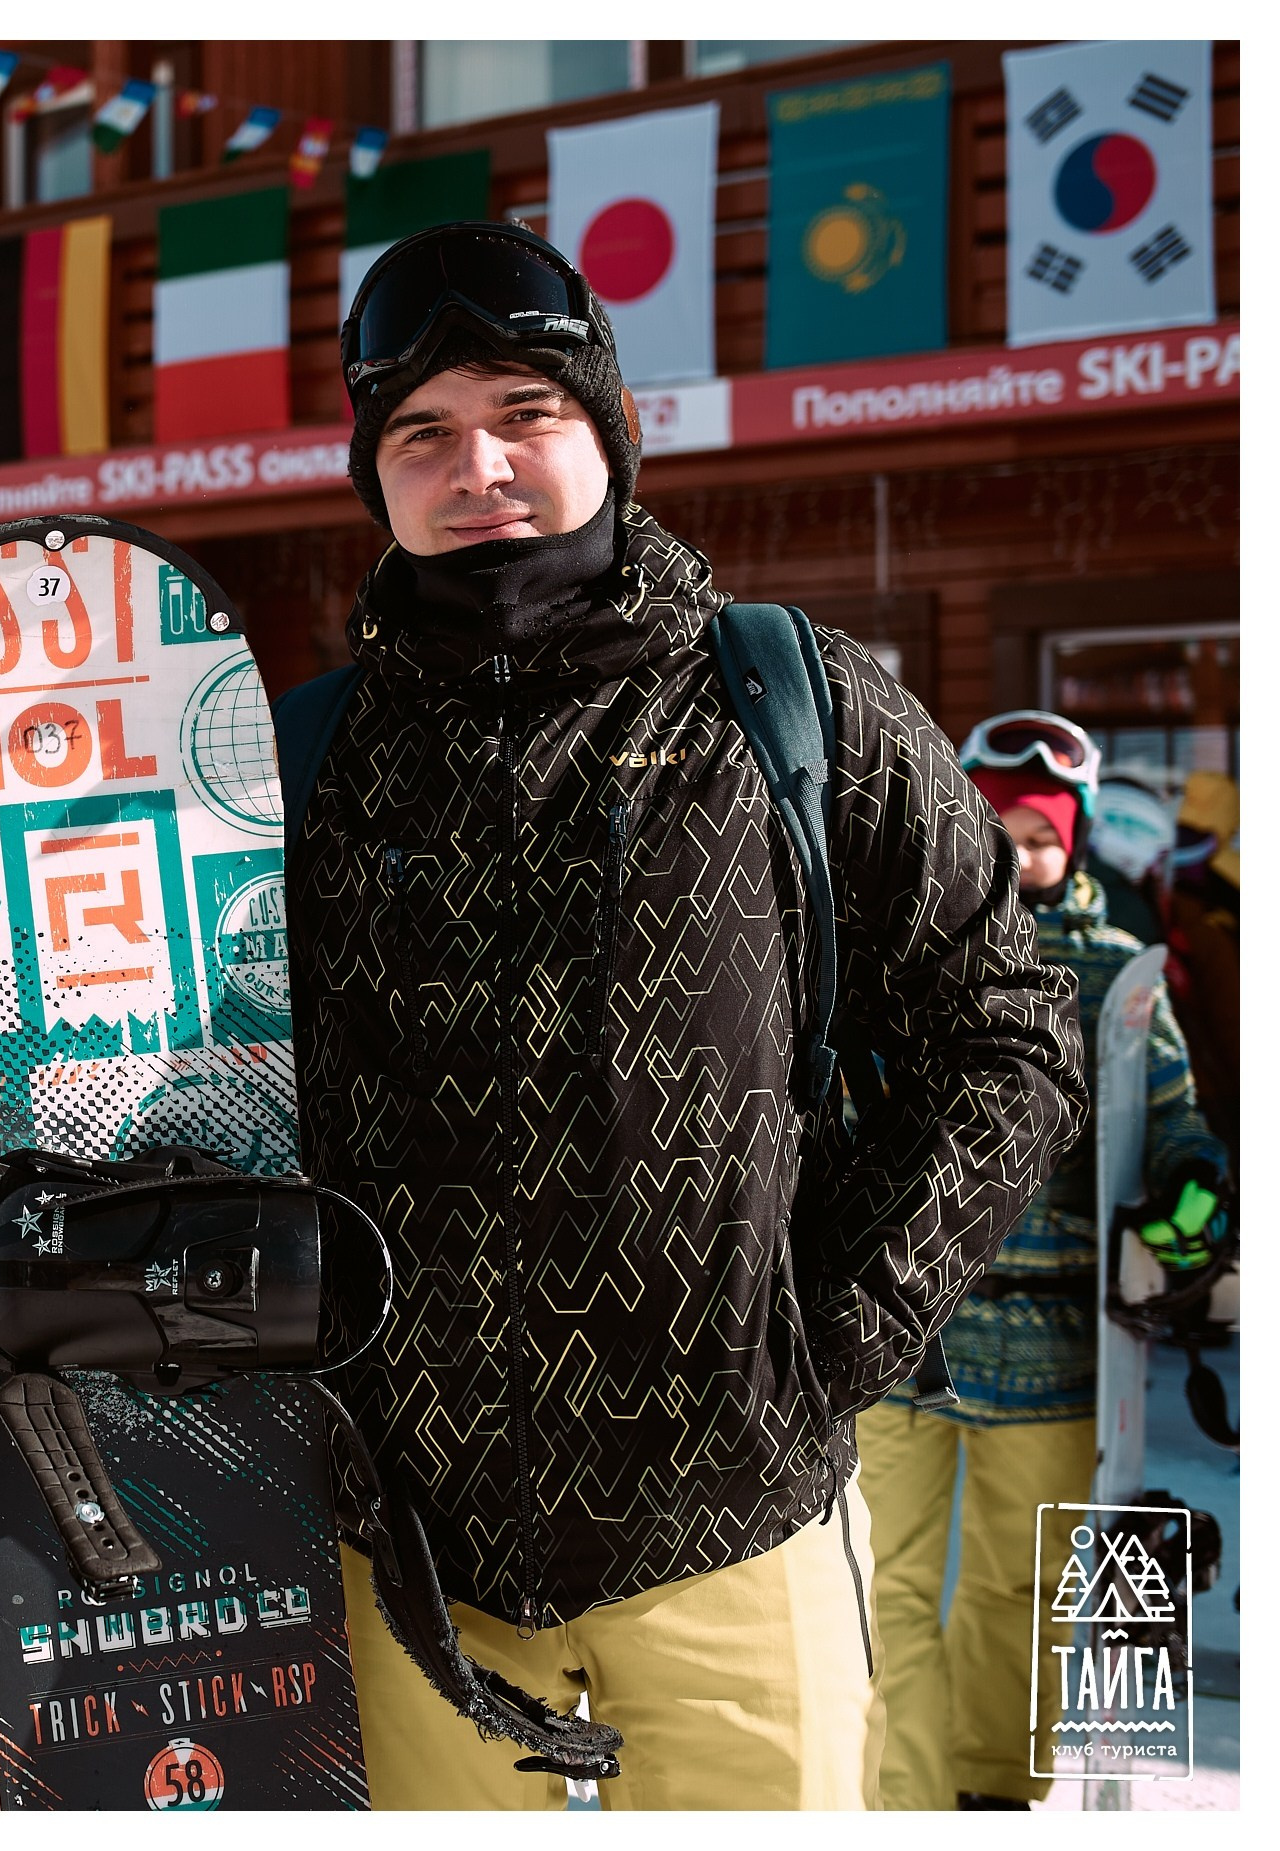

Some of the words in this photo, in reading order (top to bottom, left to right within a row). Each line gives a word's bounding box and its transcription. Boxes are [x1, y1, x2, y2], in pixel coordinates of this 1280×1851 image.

[793, 363, 1063, 429] Пополняйте
[98, 443, 254, 501] SKI-PASS
[38, 577, 61, 597] 37
[29, 1691, 121, 1745] TRICK
[159, 1672, 248, 1725] STICK
[271, 1662, 316, 1708] RSP
[165, 1759, 206, 1807] 58
